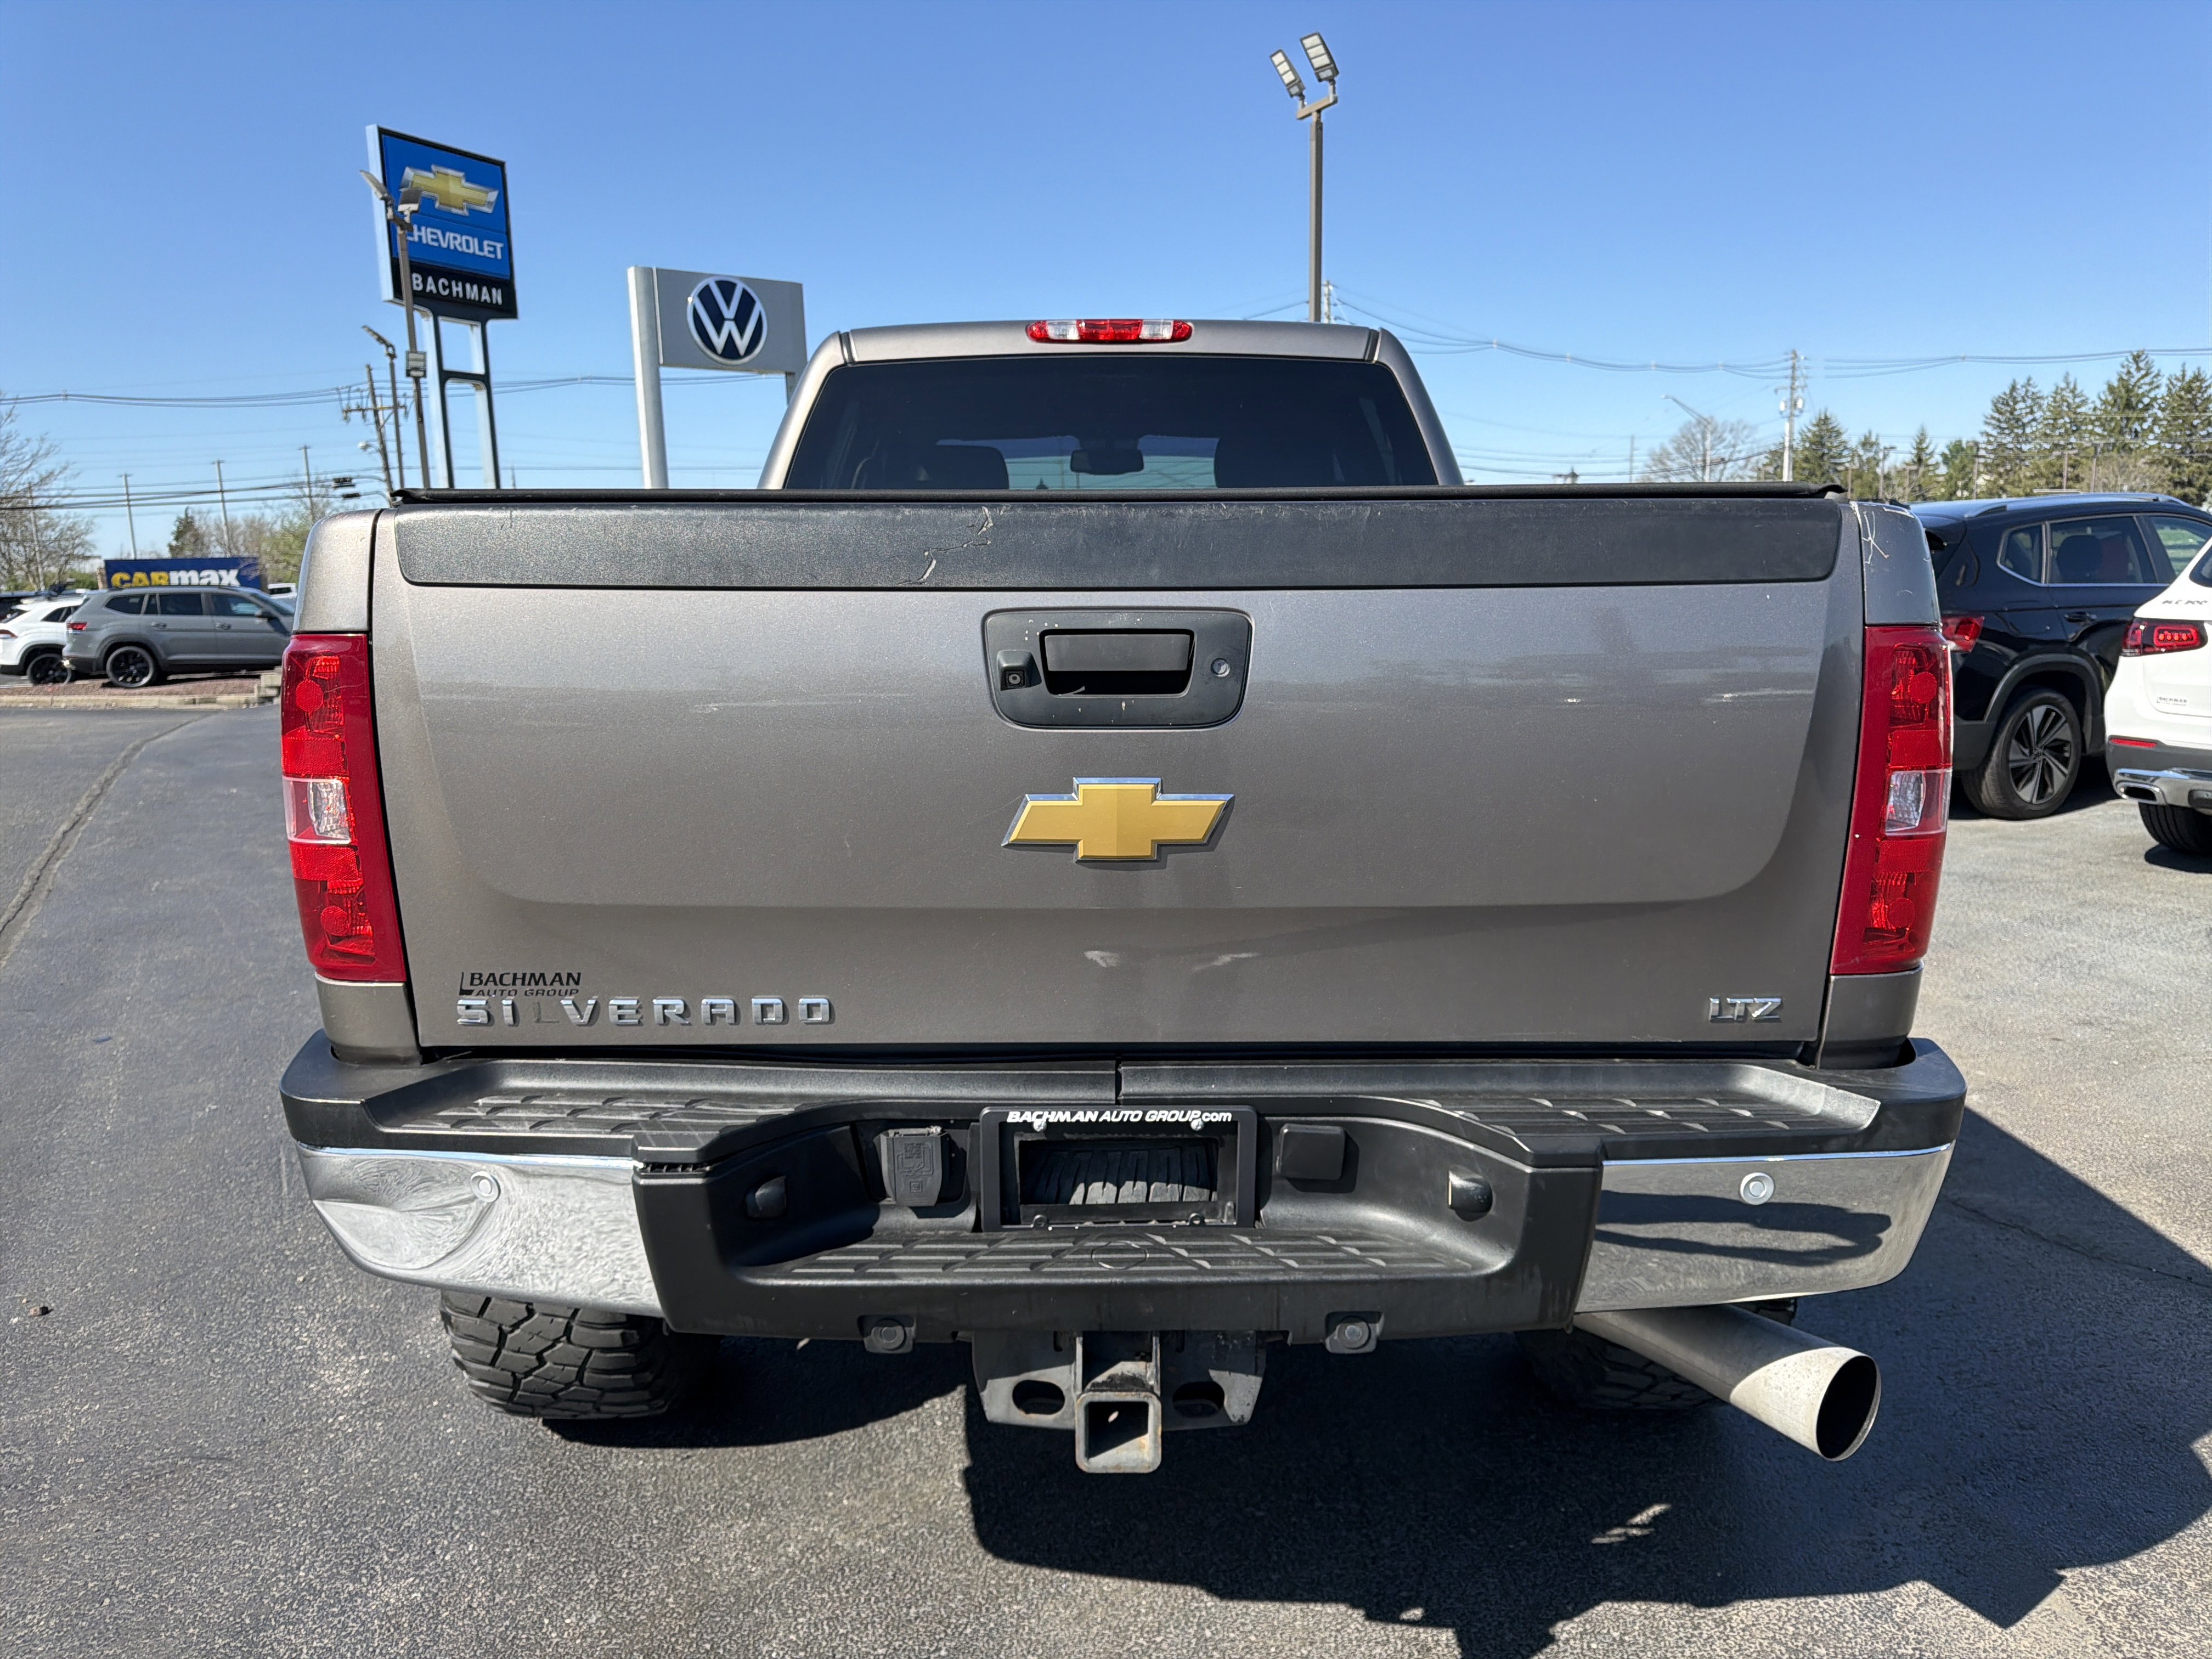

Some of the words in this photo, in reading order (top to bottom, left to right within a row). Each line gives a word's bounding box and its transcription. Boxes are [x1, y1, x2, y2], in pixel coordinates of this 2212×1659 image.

[412, 272, 503, 305] BACHMAN
[470, 972, 582, 986] BACHMAN
[475, 989, 518, 997] AUTO
[524, 989, 579, 997] GROUP
[1708, 997, 1782, 1022] LTZ
[1007, 1111, 1102, 1122] BACHMAN
[1098, 1110, 1143, 1122] AUTO
[1144, 1110, 1232, 1122] GROUP.com
